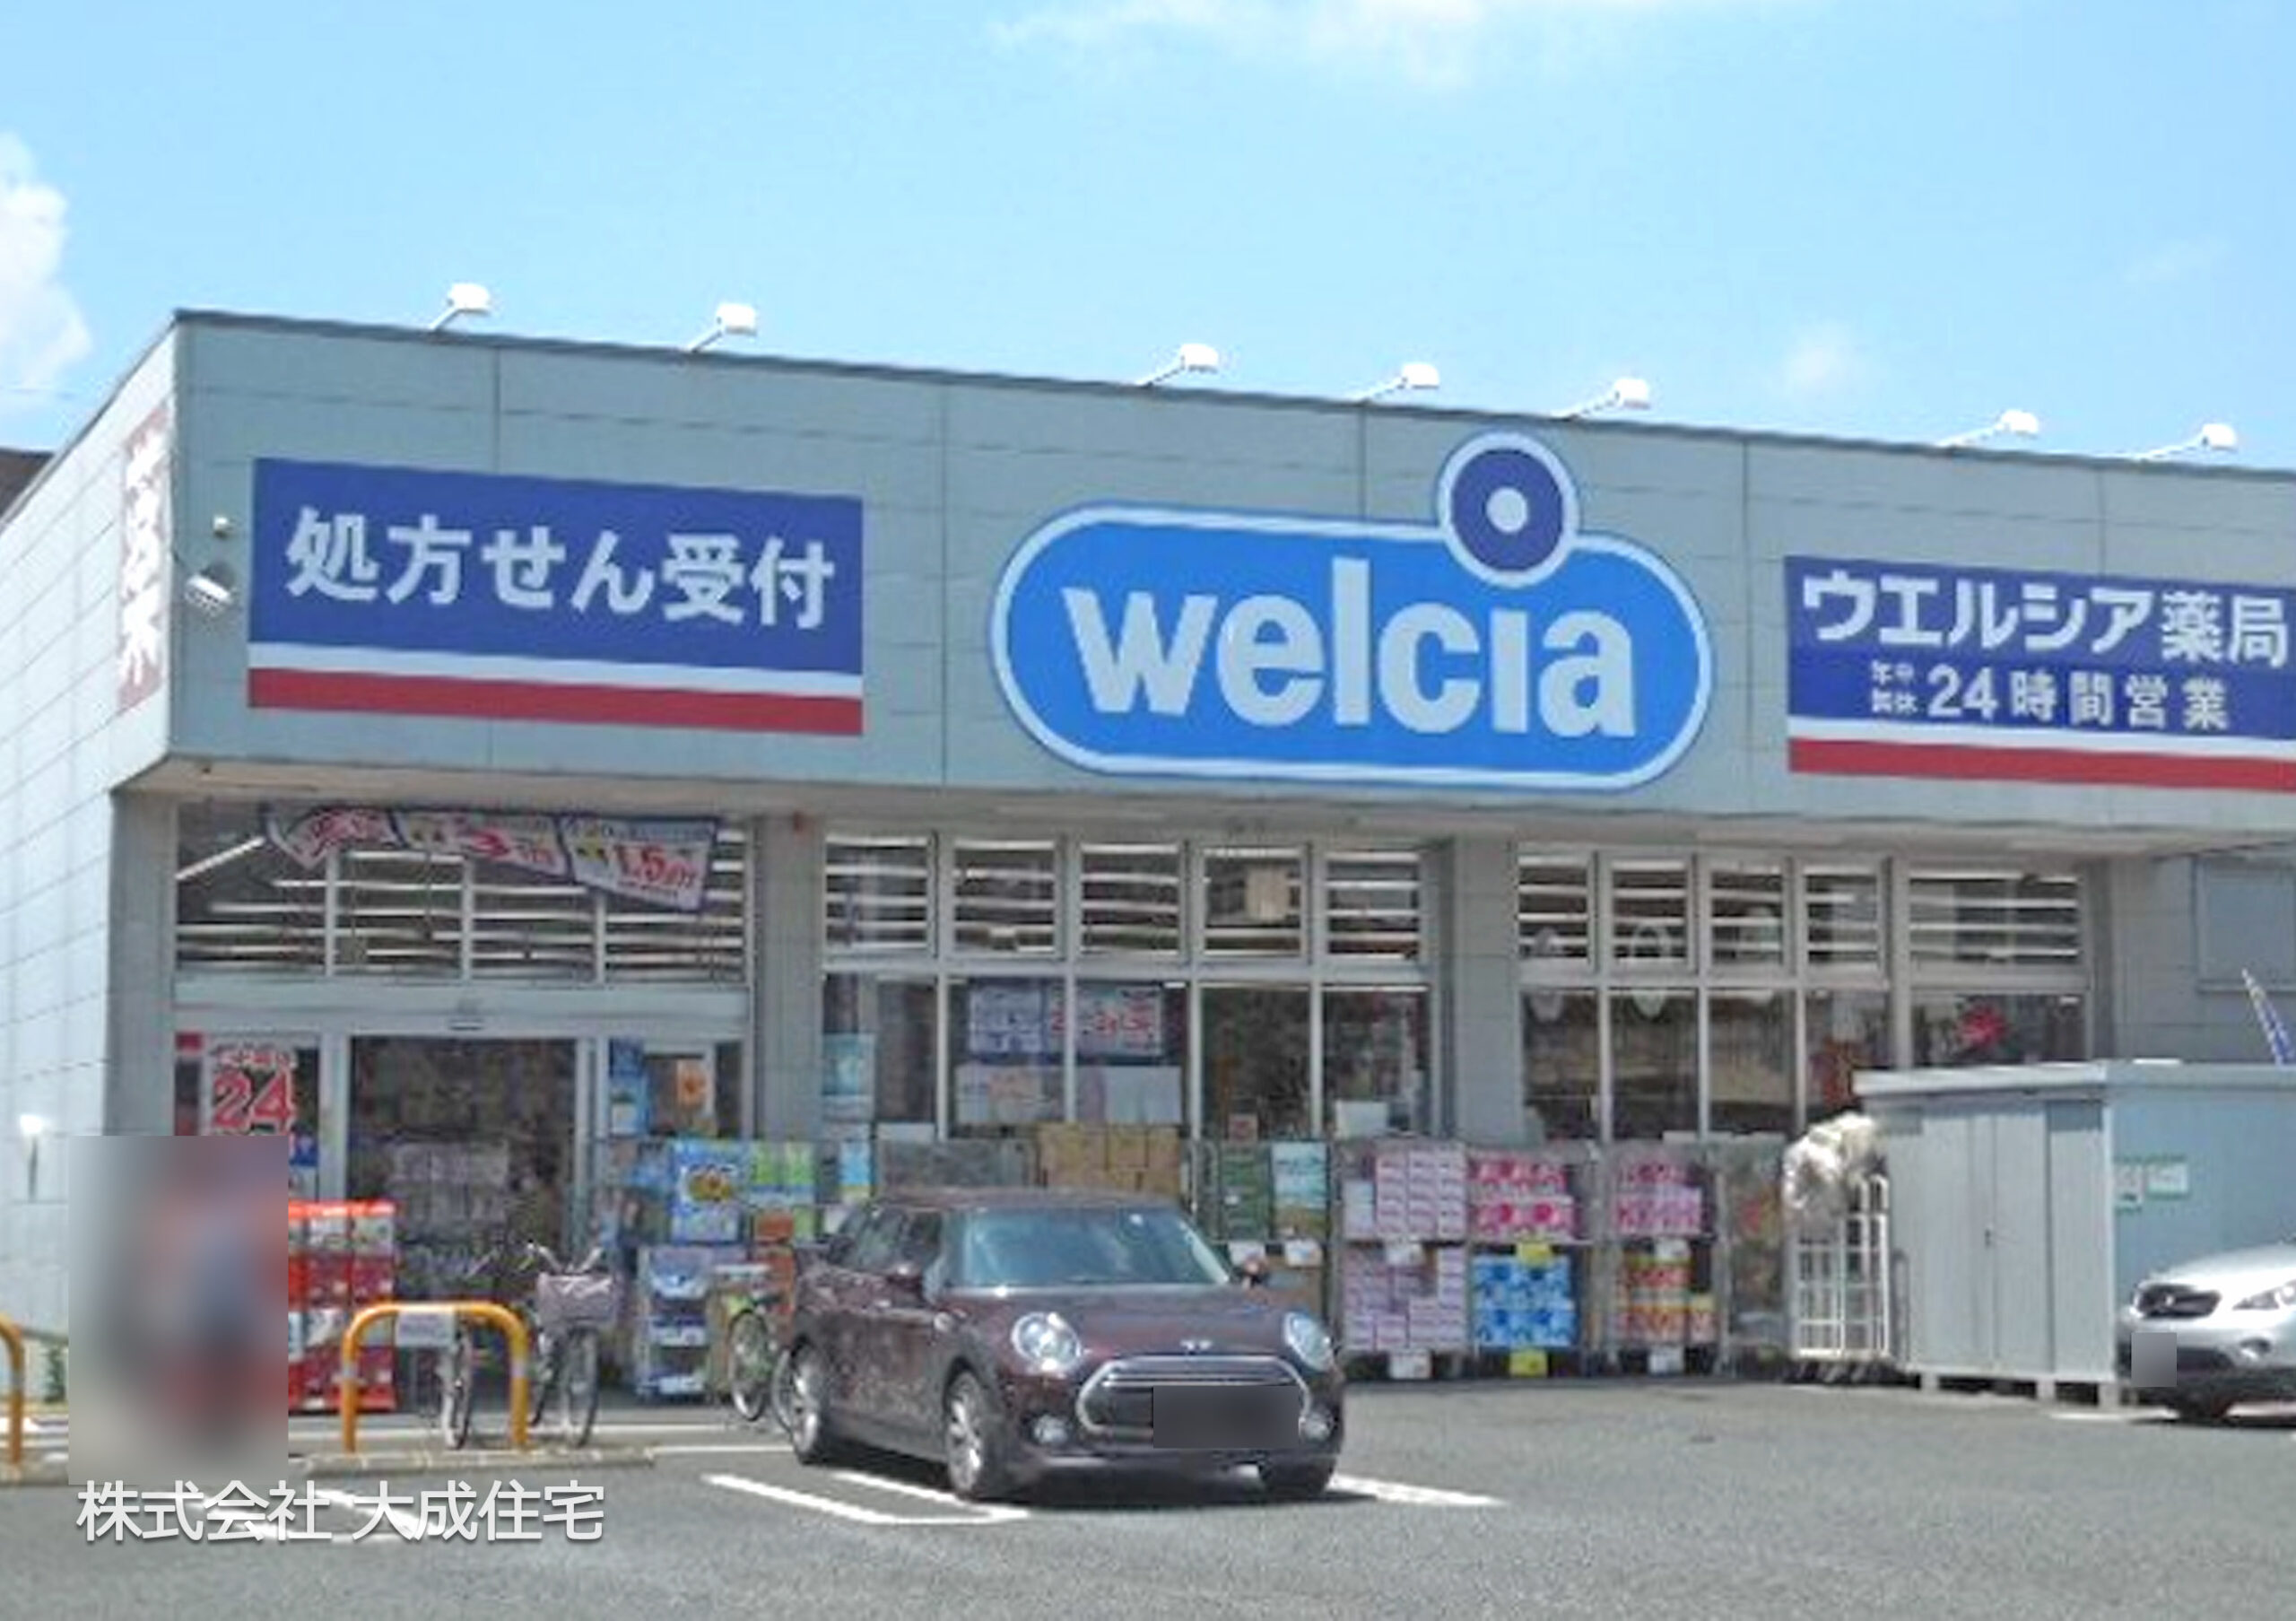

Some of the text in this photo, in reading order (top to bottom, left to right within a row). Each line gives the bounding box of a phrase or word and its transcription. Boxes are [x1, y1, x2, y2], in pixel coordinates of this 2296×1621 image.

[285, 505, 836, 630] 処方せん受付
[1061, 555, 1637, 737] welcia
[1803, 570, 2289, 667] ウエルシア薬局
[1927, 664, 2228, 731] 24時間営業
[213, 1067, 296, 1136] 24
